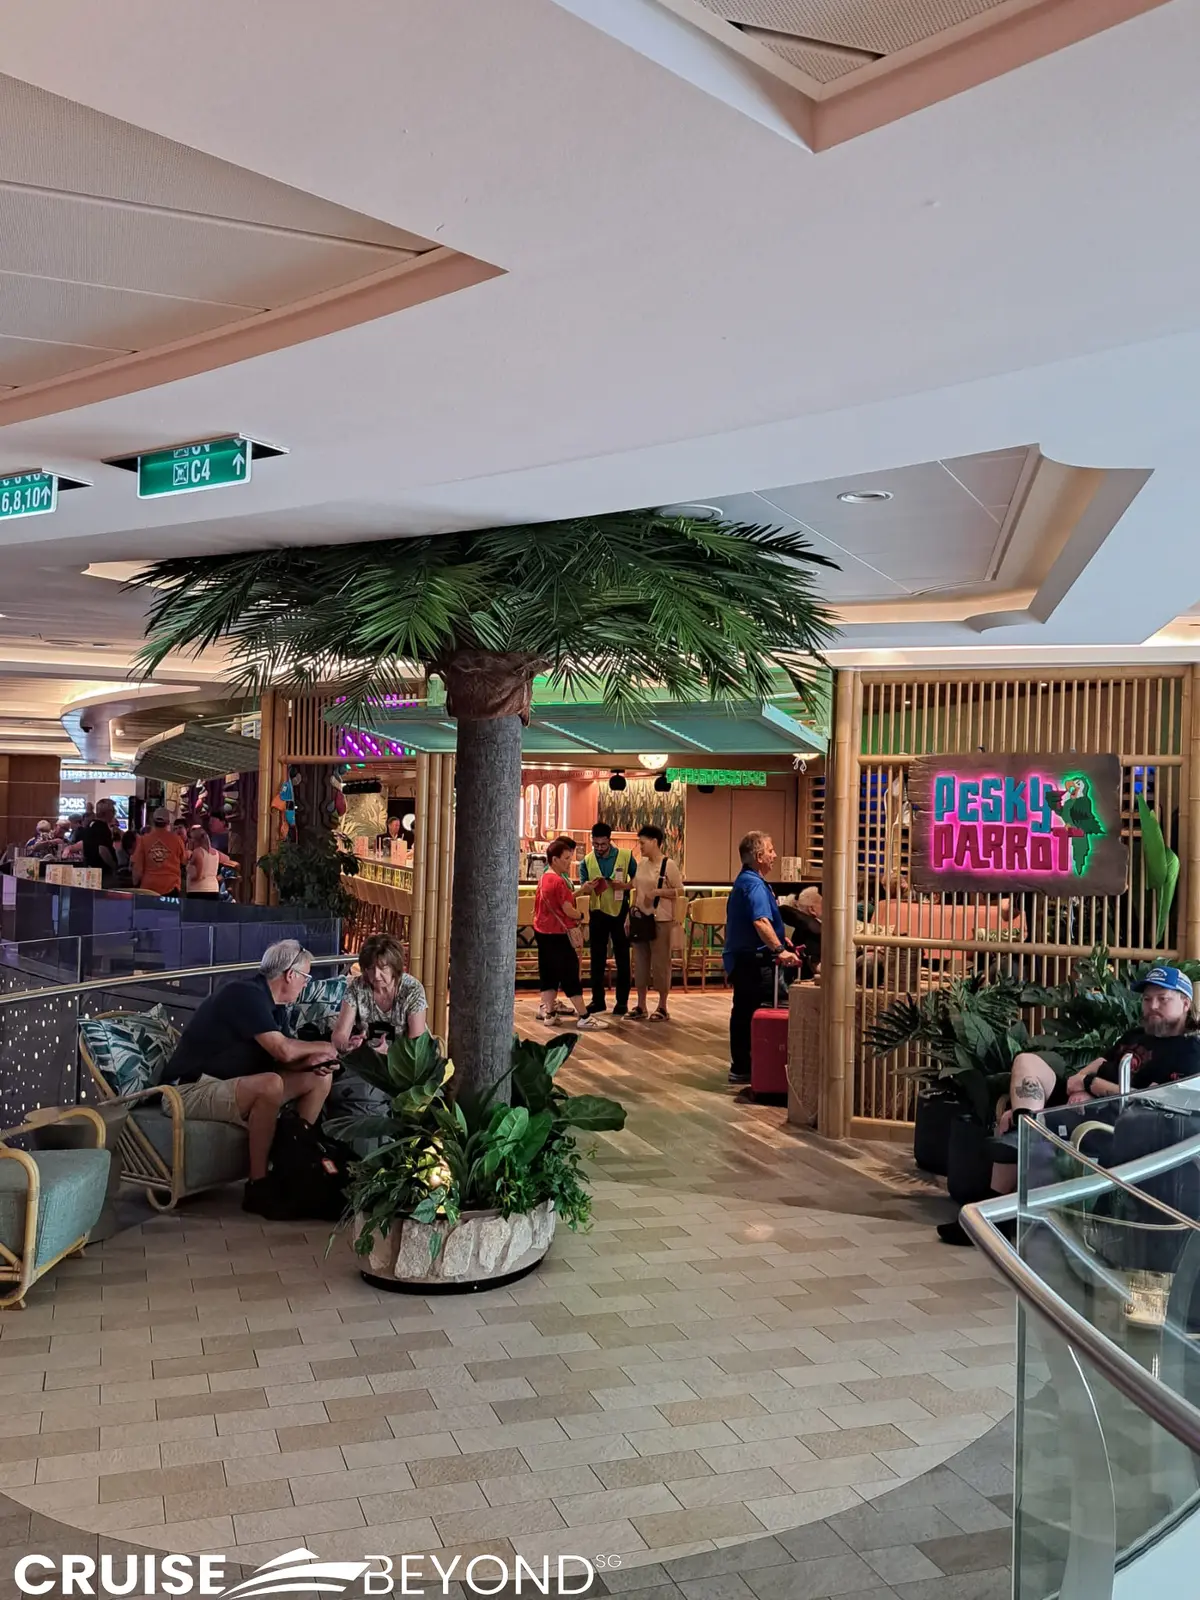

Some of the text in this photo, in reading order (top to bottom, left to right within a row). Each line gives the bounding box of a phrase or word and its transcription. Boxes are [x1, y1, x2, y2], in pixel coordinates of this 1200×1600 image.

[191, 458, 210, 483] C4
[1, 487, 41, 515] 6,8,10
[934, 776, 1052, 833] PESKY
[932, 824, 1080, 871] PARROT
